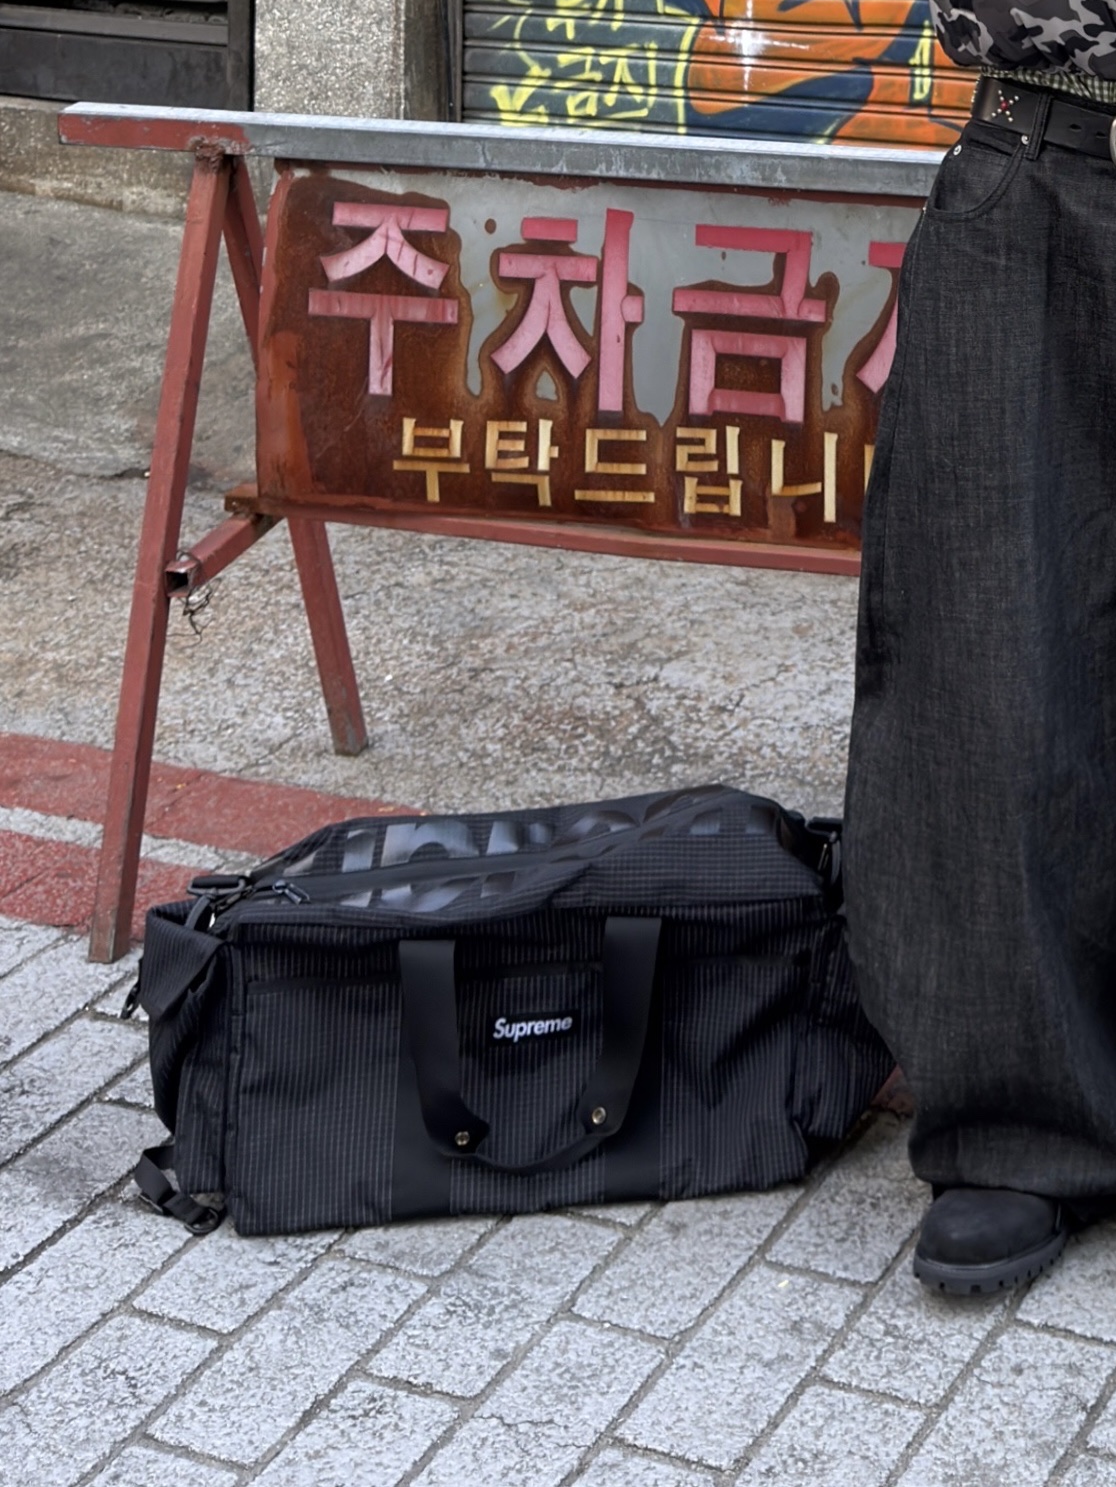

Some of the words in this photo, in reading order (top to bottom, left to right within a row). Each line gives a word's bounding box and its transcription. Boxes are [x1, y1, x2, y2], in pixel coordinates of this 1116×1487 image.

[307, 201, 908, 426] 주차금
[391, 416, 876, 524] 부탁드립니
[492, 1015, 574, 1043] Supreme
